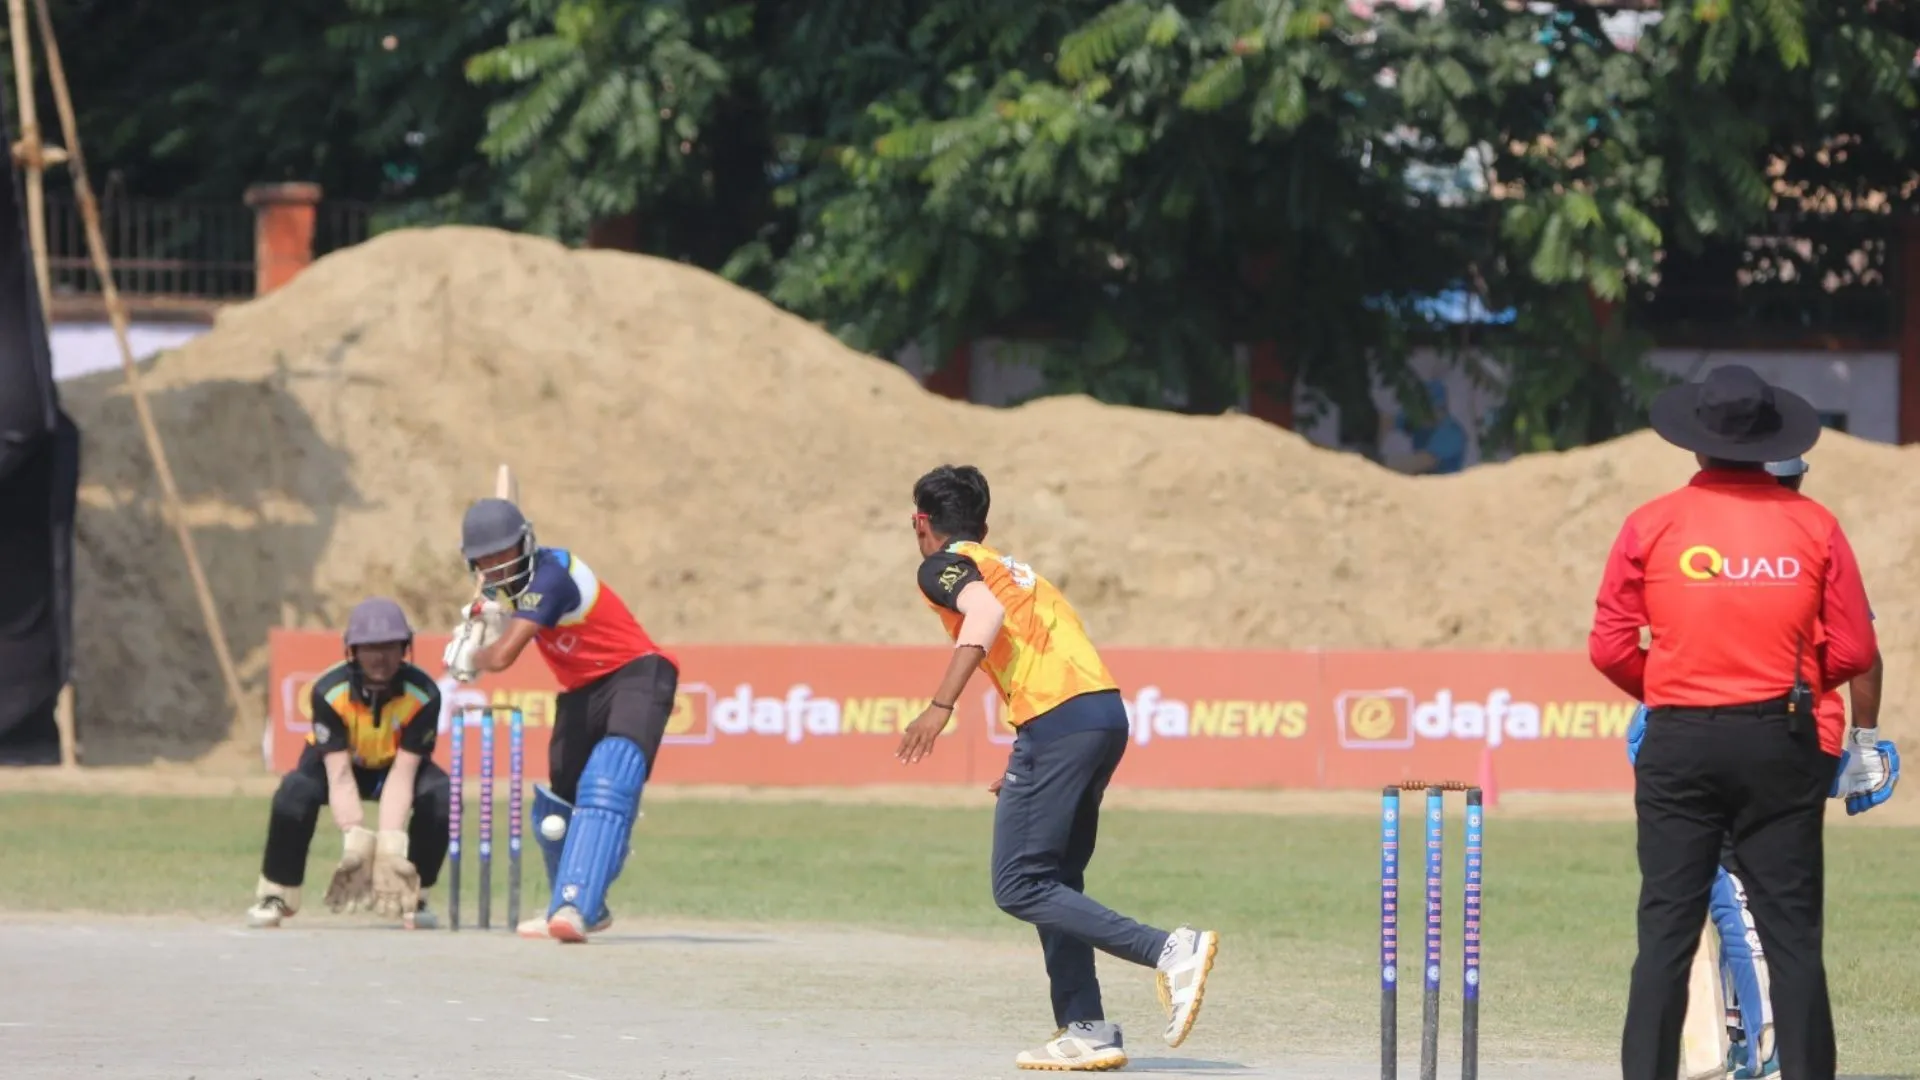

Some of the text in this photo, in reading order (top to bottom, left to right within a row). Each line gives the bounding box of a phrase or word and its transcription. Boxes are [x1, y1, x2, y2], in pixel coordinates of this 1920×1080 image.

[1680, 545, 1800, 579] QUAD
[1121, 686, 1308, 746] faNEWS
[1414, 688, 1638, 748] dafaNEW
